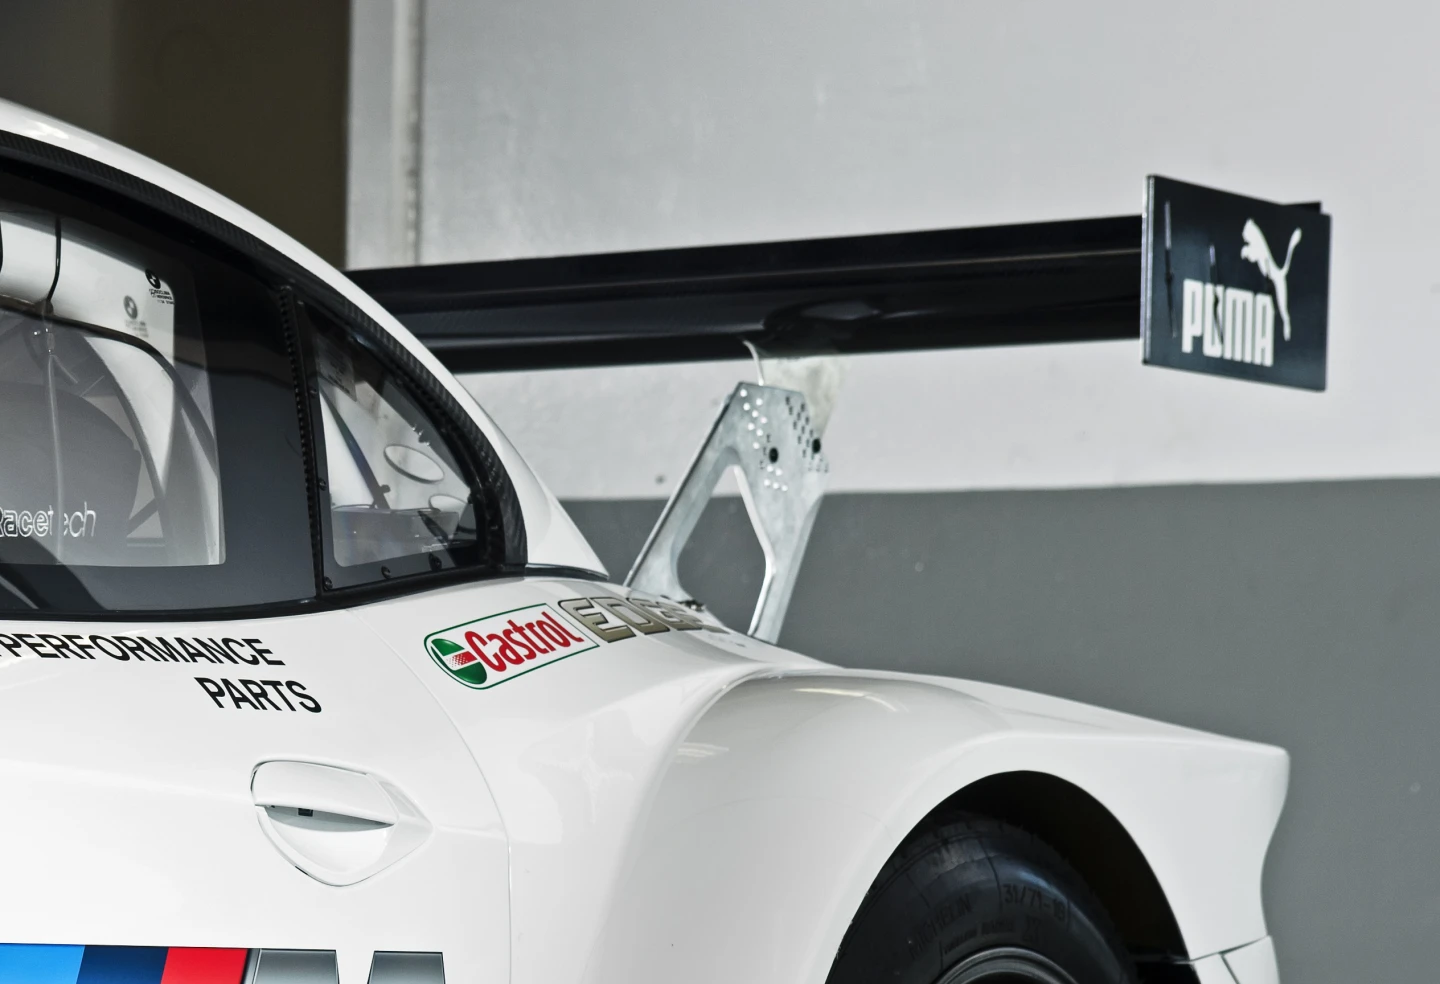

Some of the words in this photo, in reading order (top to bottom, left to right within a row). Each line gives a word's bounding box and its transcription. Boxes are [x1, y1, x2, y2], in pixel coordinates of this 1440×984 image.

[1182, 278, 1275, 367] PUMA
[464, 611, 585, 673] Castrol
[193, 676, 323, 713] PARTS
